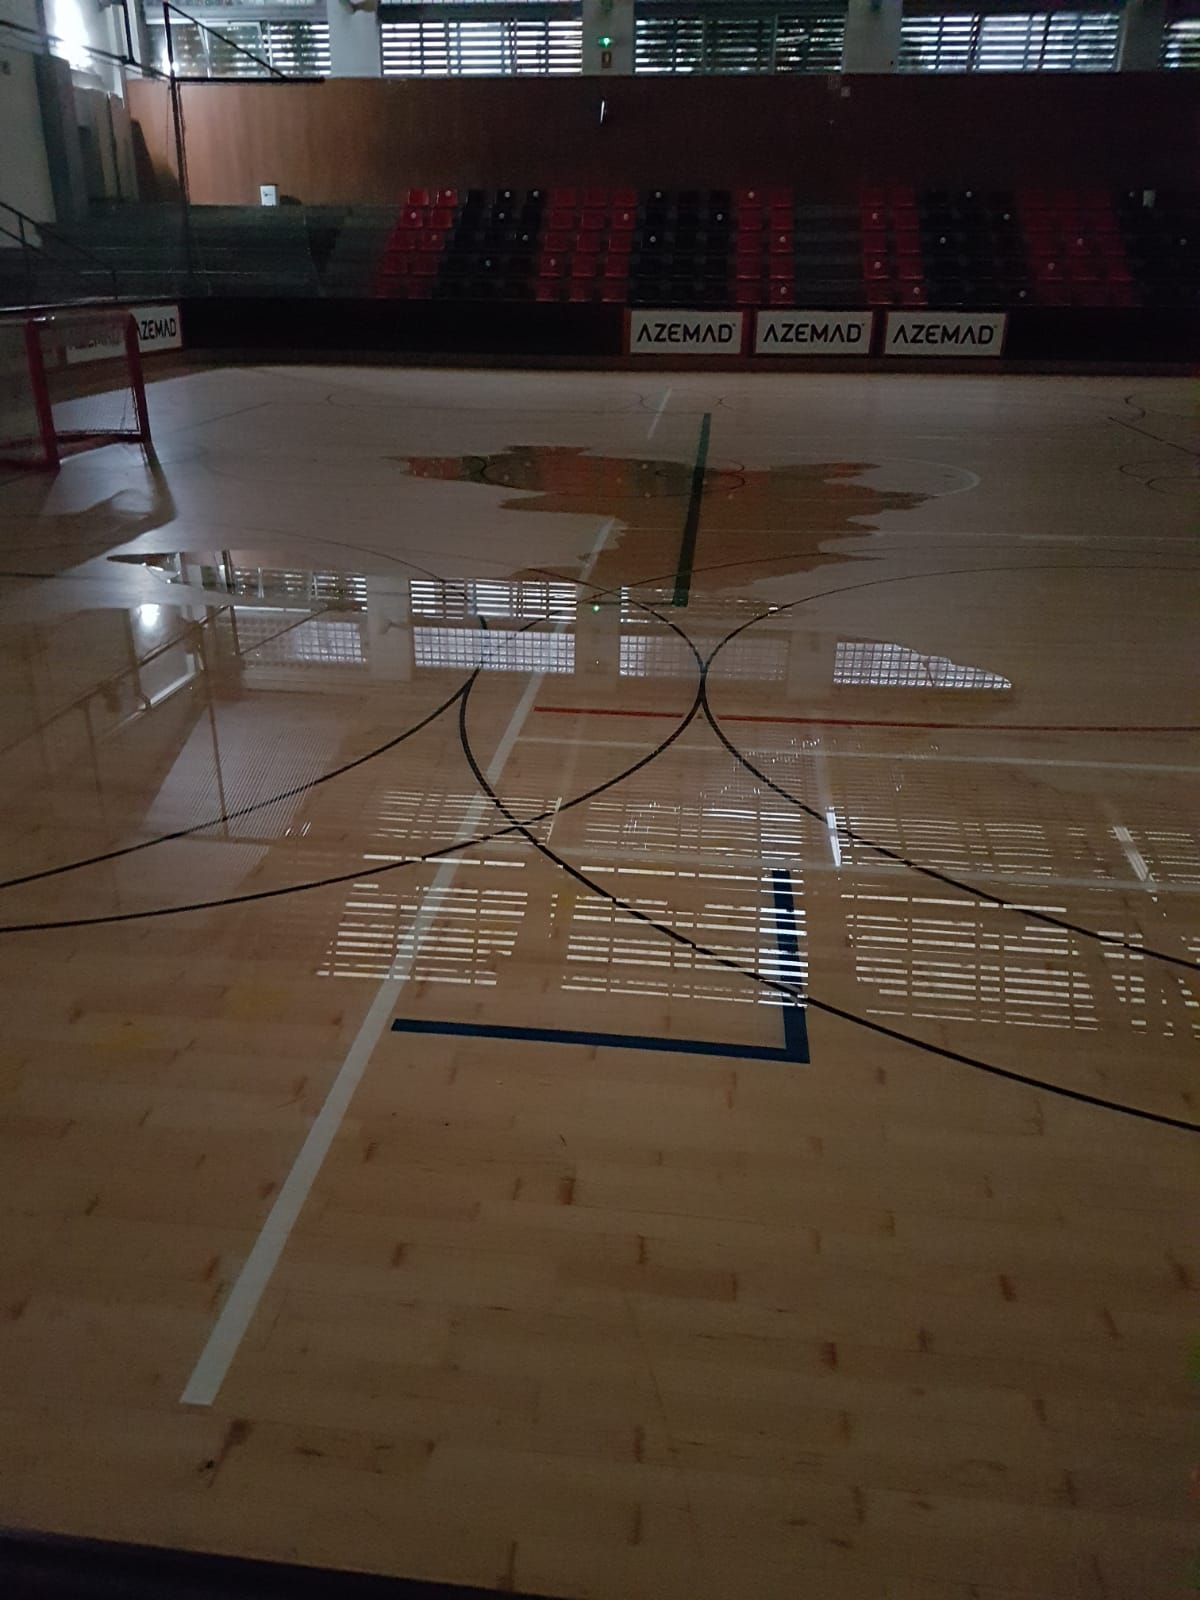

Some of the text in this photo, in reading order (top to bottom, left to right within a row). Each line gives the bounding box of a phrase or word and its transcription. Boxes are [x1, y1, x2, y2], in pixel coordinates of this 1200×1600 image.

[637, 323, 733, 343] AZEMAD
[763, 323, 862, 343] AZEMAD
[893, 323, 995, 345] AZEMAD
